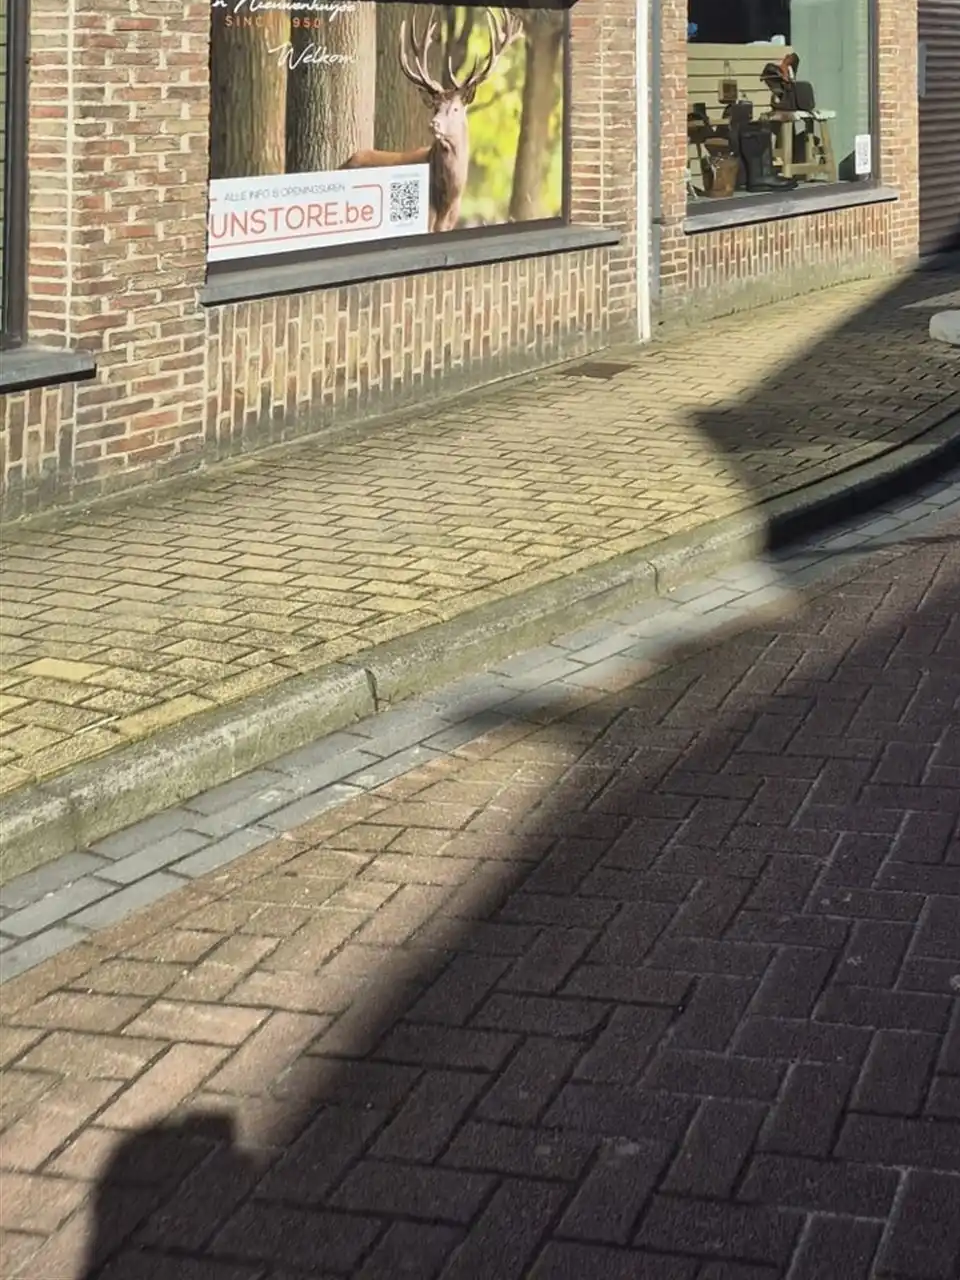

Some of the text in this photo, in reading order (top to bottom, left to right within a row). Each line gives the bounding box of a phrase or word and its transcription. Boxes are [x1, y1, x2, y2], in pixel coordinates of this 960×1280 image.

[224, 15, 322, 29] SINC 950
[267, 40, 358, 70] Welkom
[224, 191, 247, 201] ALLE
[210, 200, 375, 239] UNSTORE.be
